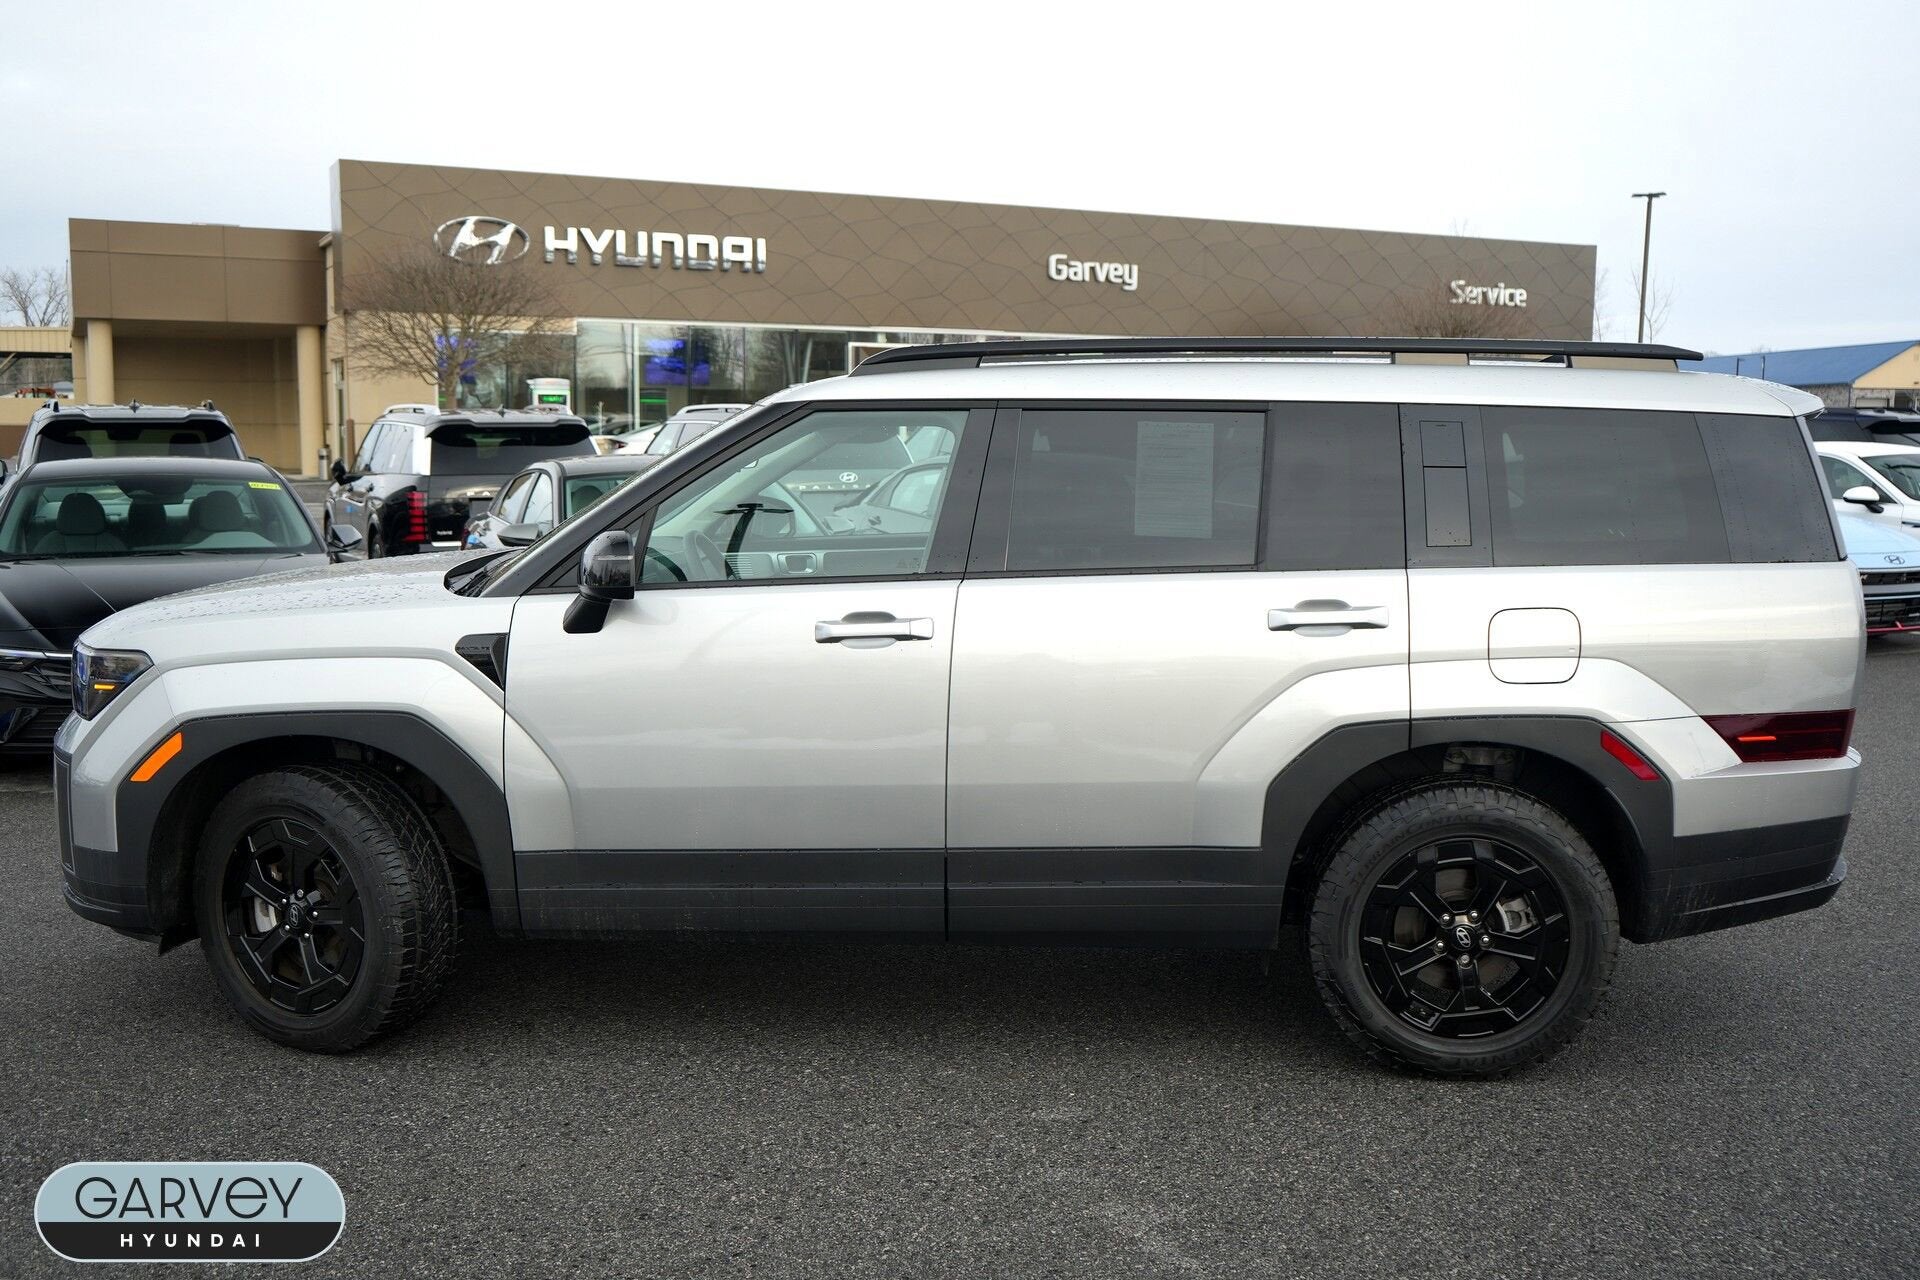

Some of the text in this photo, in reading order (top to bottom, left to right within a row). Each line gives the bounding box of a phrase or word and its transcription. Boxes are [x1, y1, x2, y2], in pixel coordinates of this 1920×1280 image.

[544, 226, 767, 273] HYUNDAI
[1048, 253, 1139, 291] Garvey
[1450, 280, 1528, 307] Service
